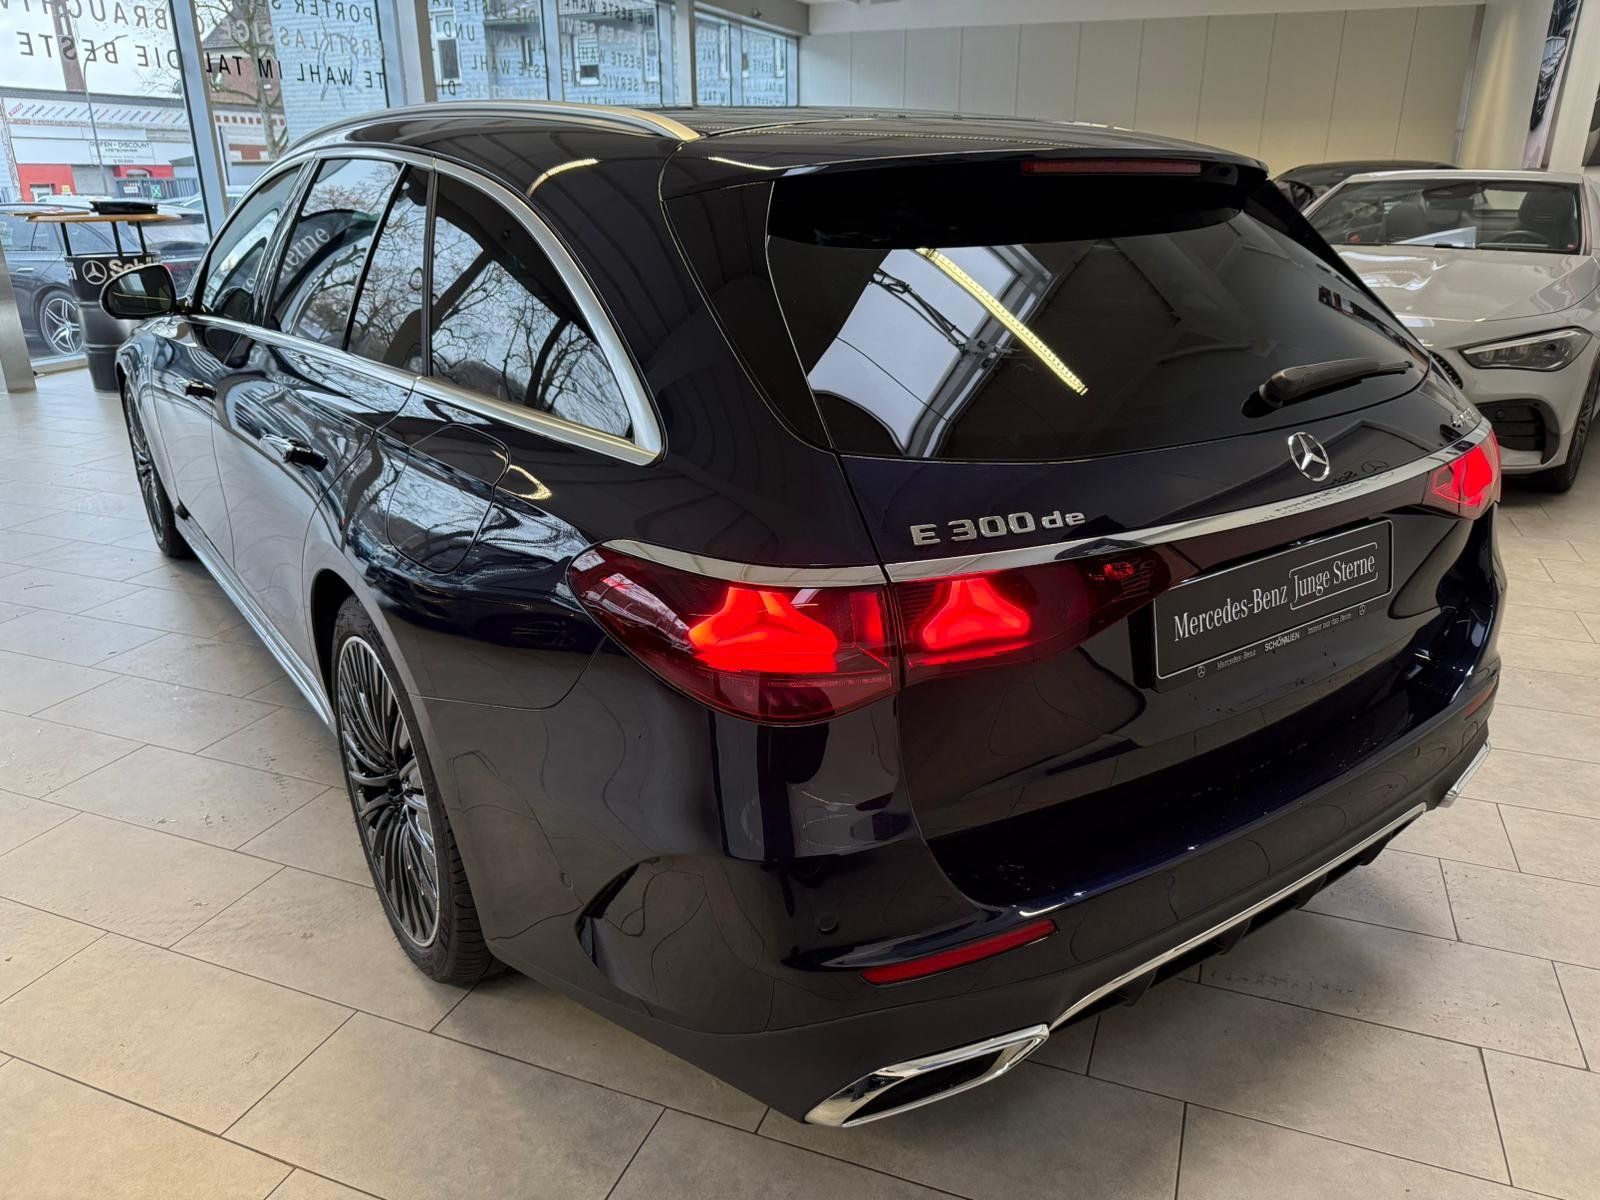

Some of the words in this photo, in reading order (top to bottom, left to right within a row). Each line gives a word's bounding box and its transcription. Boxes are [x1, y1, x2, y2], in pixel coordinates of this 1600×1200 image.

[909, 523, 940, 546] E
[948, 511, 1036, 542] 300
[1041, 510, 1086, 529] de
[1173, 584, 1288, 642] Mercedes-Benz
[1293, 570, 1330, 603] Junge
[1333, 555, 1376, 584] Sterne
